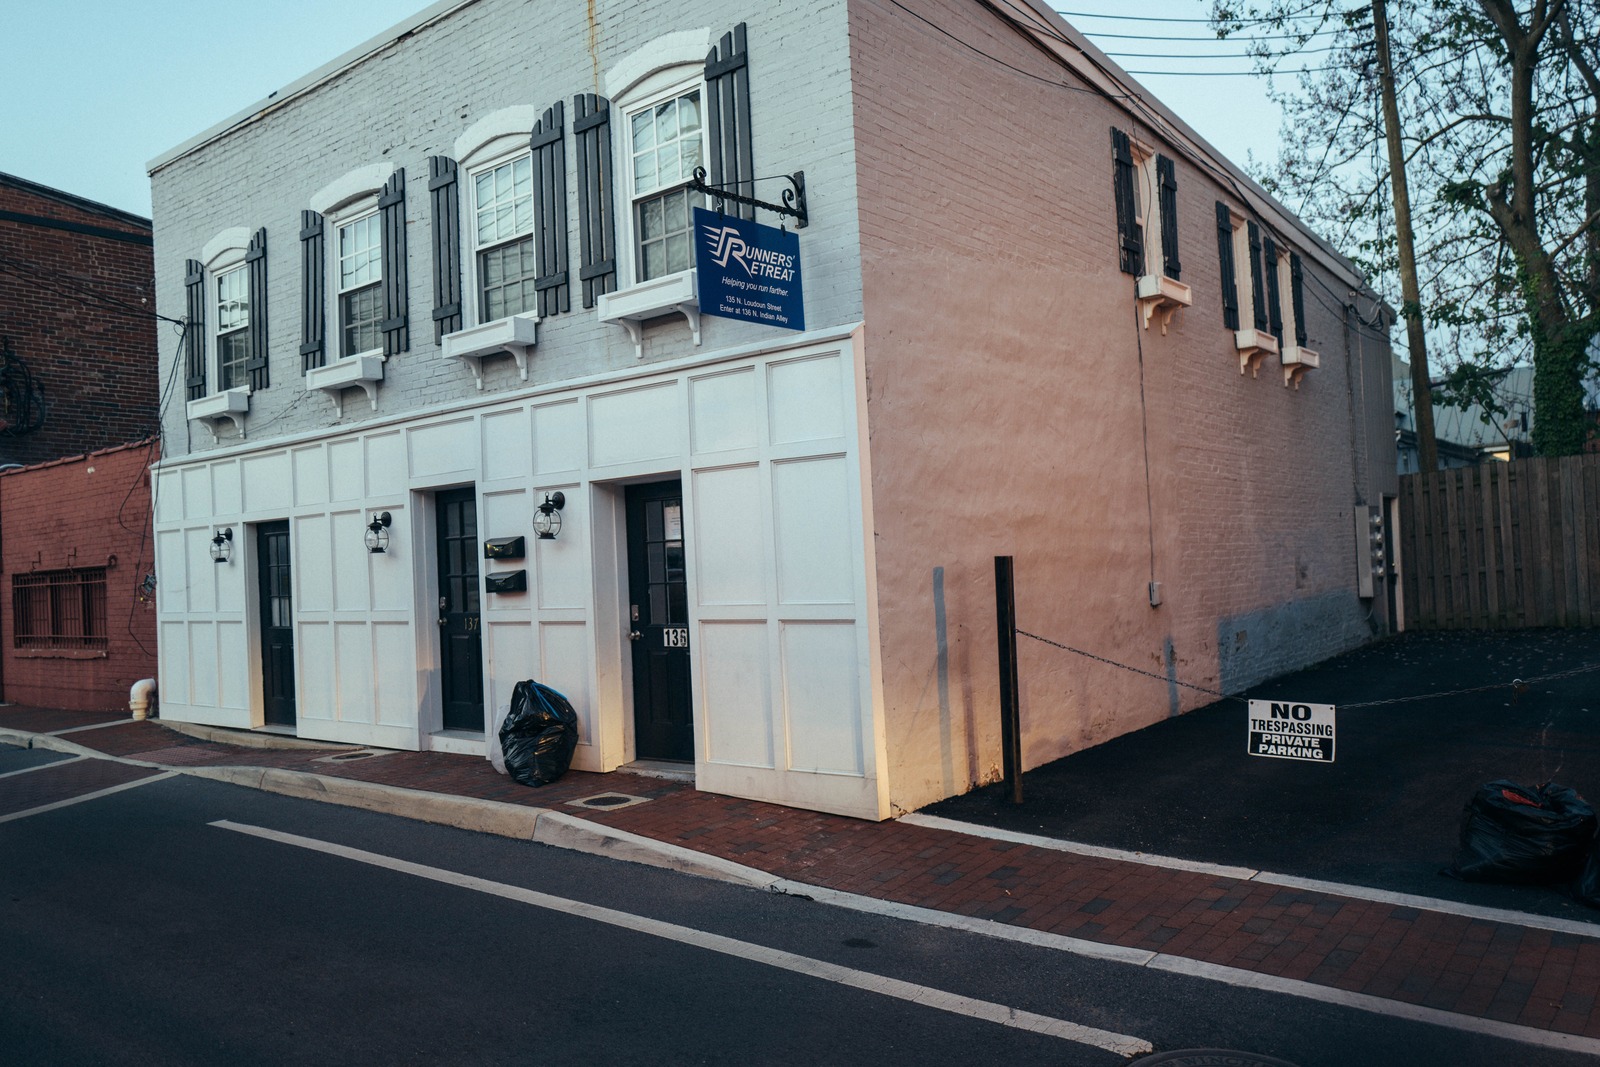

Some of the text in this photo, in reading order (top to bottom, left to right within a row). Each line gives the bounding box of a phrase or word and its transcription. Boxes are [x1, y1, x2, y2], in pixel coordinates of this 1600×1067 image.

[722, 277, 745, 289] Helping
[746, 283, 757, 291] you
[769, 286, 788, 296] farther.
[726, 296, 735, 304] 135
[744, 299, 766, 308] Loudoun
[767, 303, 782, 312] Street
[720, 304, 734, 313] Enter
[735, 306, 741, 314] at
[742, 307, 752, 316] 136
[760, 311, 775, 320] Indian
[776, 314, 789, 324] Alley
[464, 617, 479, 630] 137
[1271, 703, 1311, 721] NO
[1251, 719, 1333, 736] TRESPASSING
[1262, 734, 1320, 747] PRIVATE
[1259, 744, 1323, 759] PARKING
